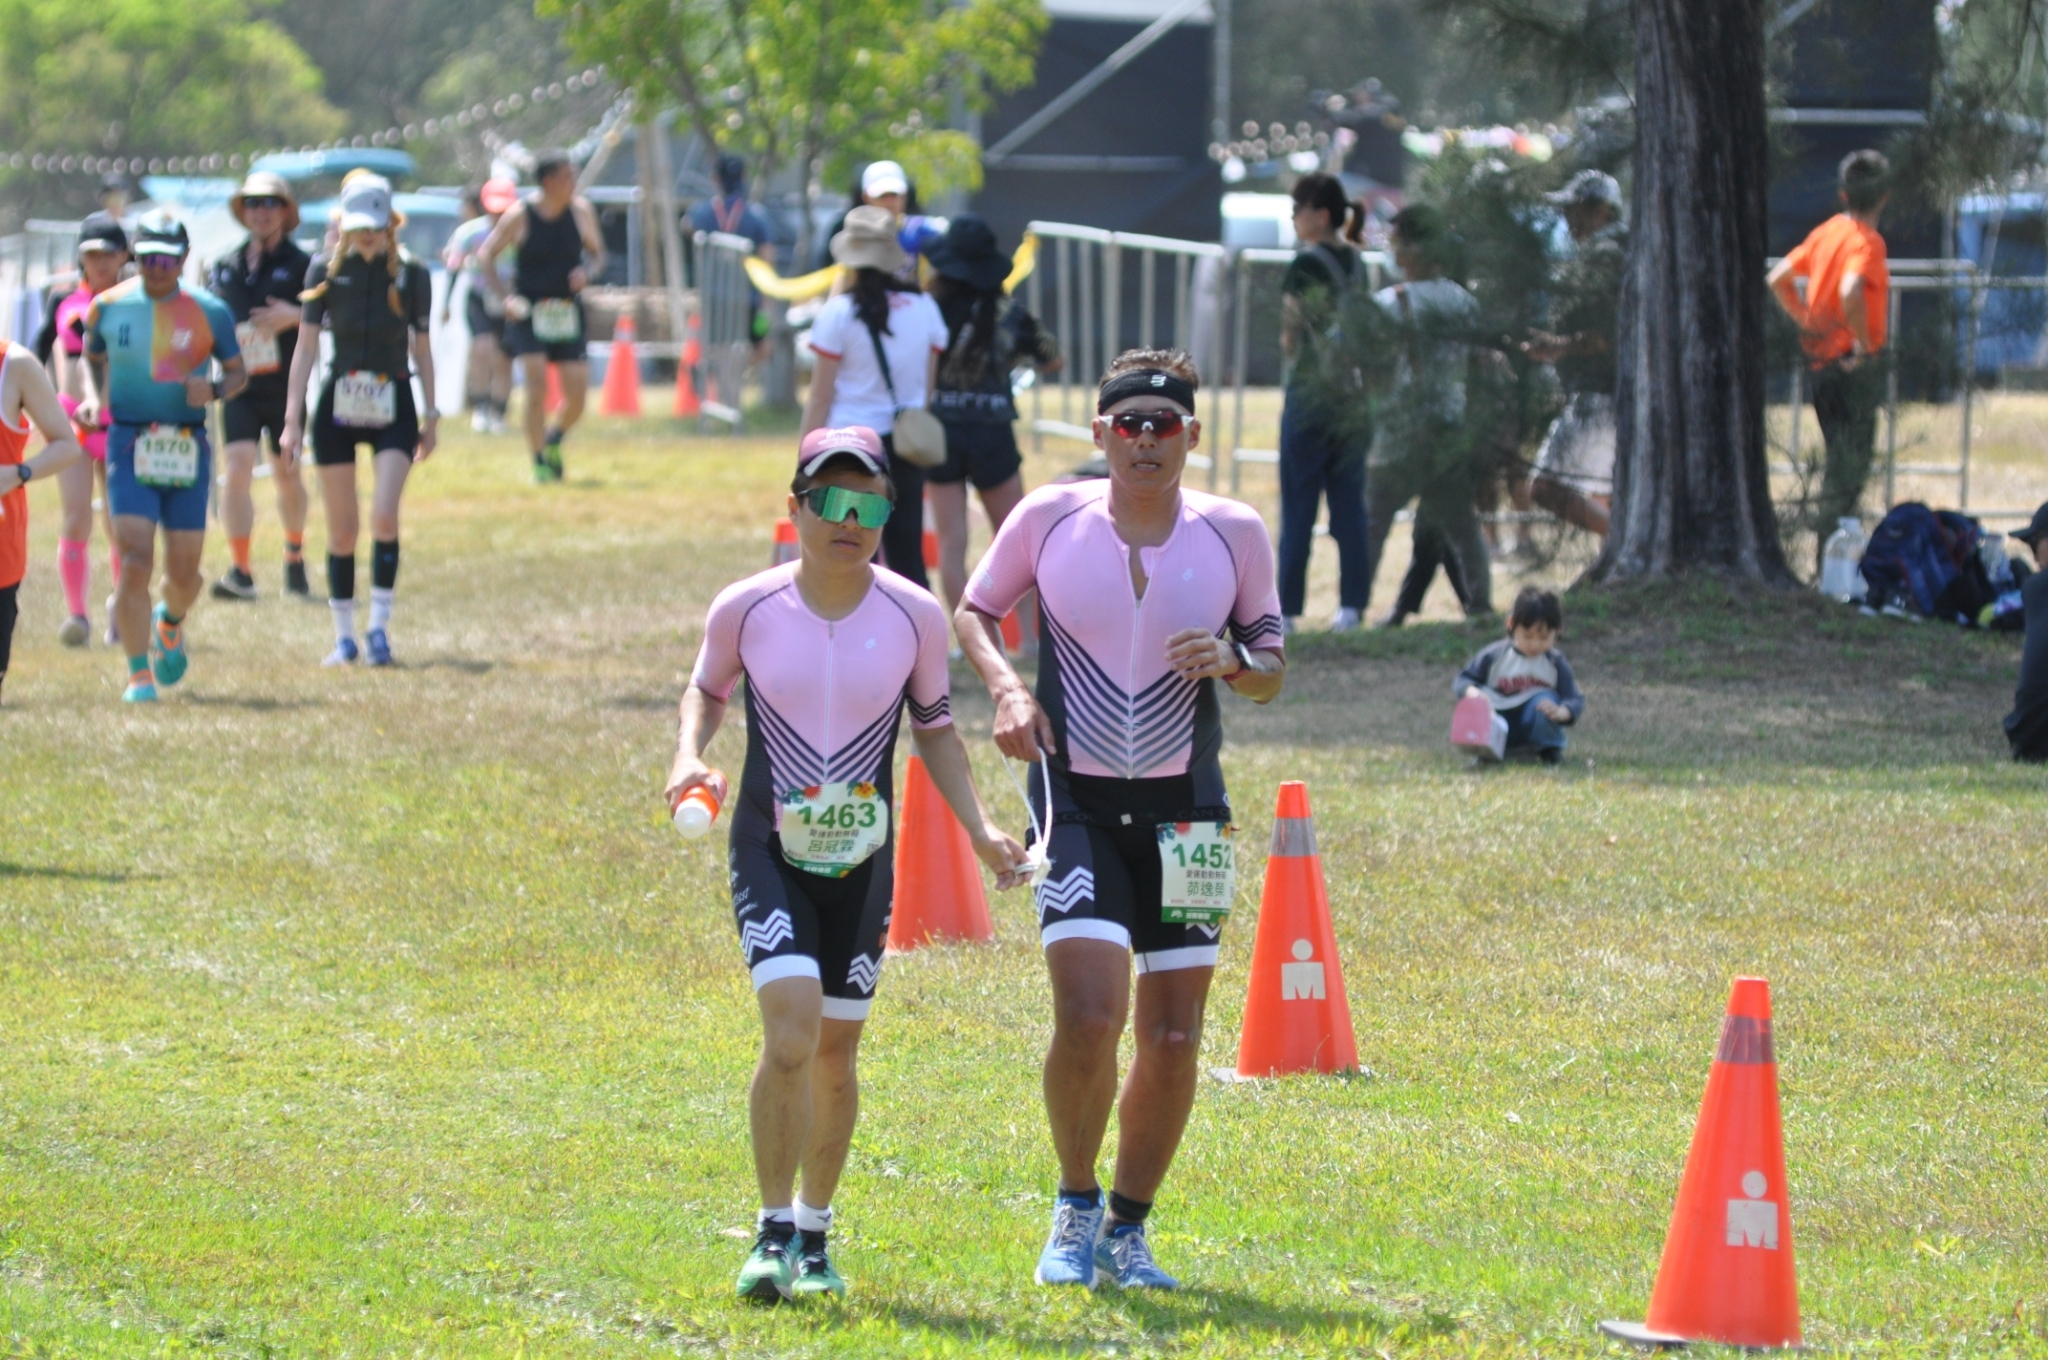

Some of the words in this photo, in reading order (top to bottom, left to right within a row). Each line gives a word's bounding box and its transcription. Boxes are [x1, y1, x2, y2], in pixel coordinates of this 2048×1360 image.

[143, 438, 191, 455] 1570
[798, 803, 875, 828] 1463
[808, 840, 854, 853] 呂冠霖
[1172, 843, 1231, 869] 1452
